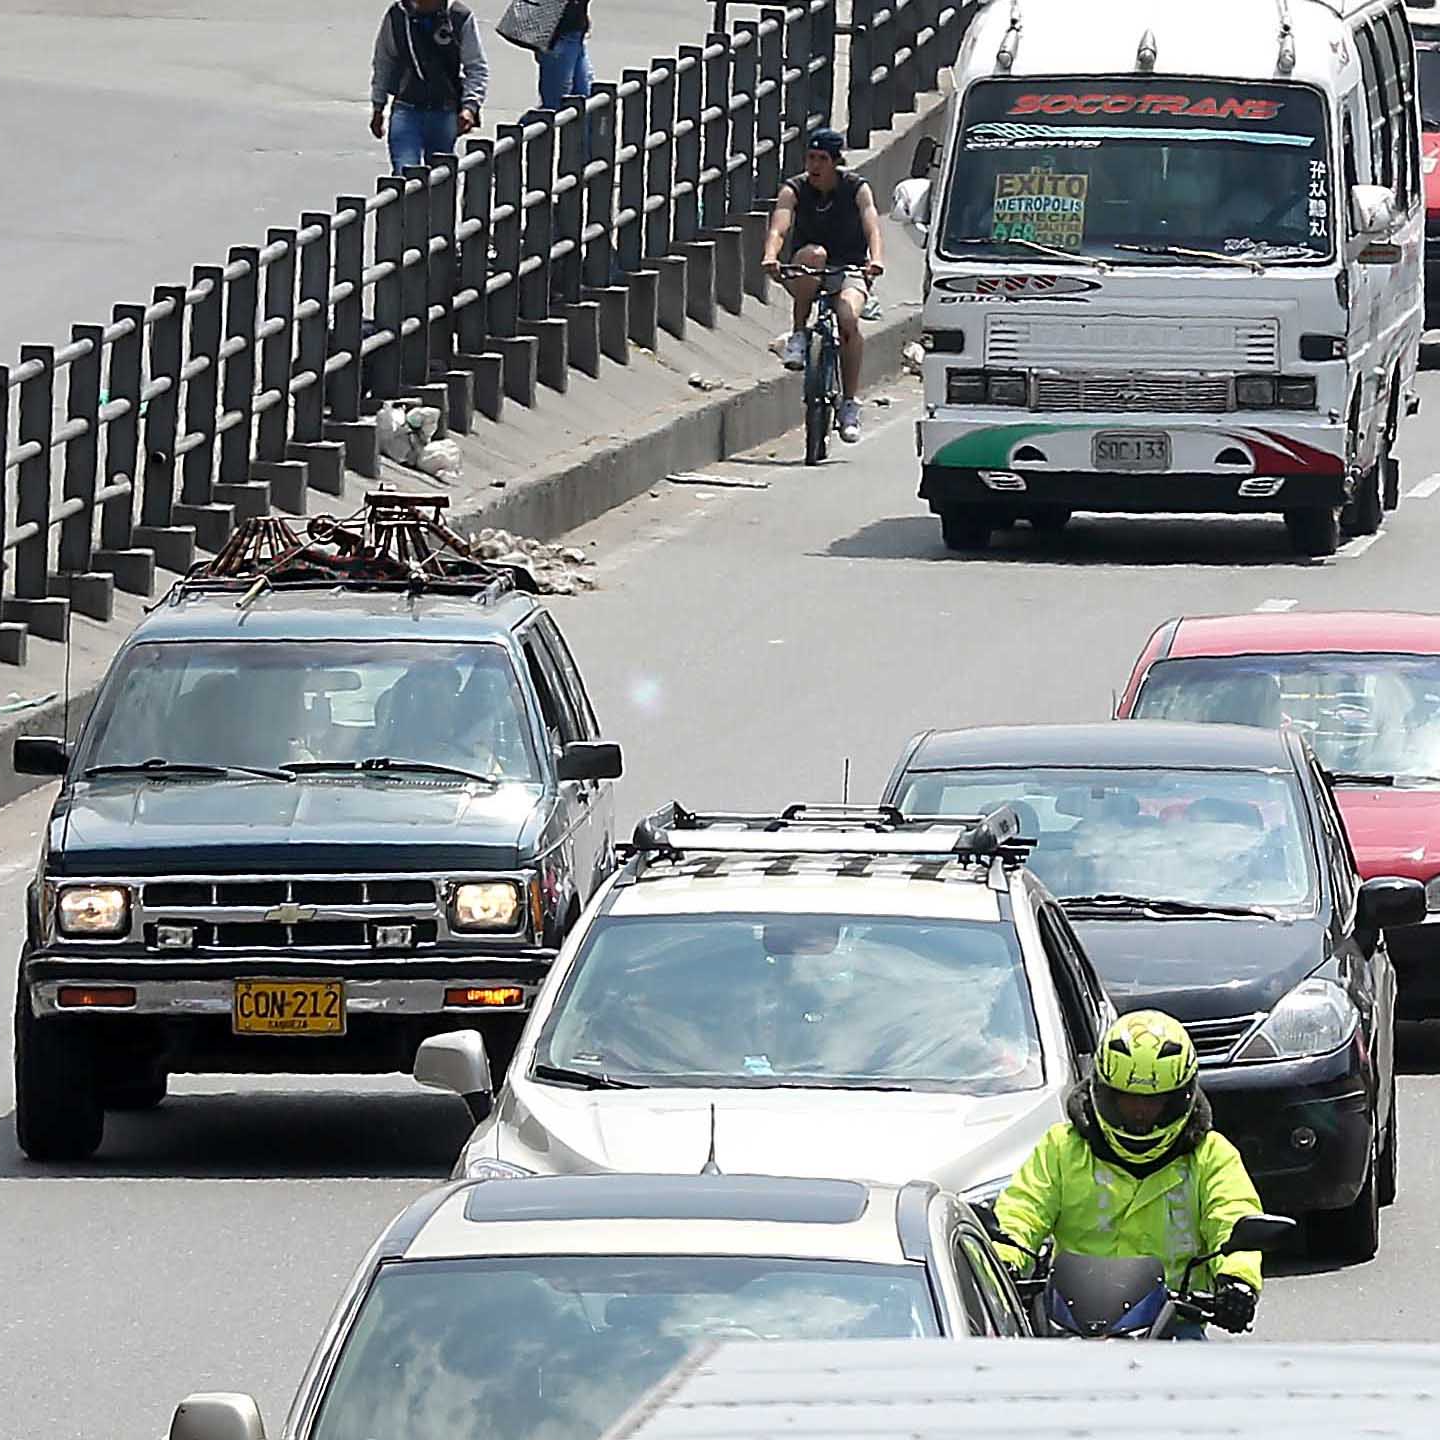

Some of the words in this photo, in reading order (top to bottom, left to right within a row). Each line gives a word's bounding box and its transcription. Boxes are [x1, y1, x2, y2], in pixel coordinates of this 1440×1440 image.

[1006, 94, 1284, 121] SOCOTRANS
[998, 175, 1086, 199] EXITO
[995, 197, 1082, 212] METROPOLIS
[995, 211, 1081, 222] VENECIA
